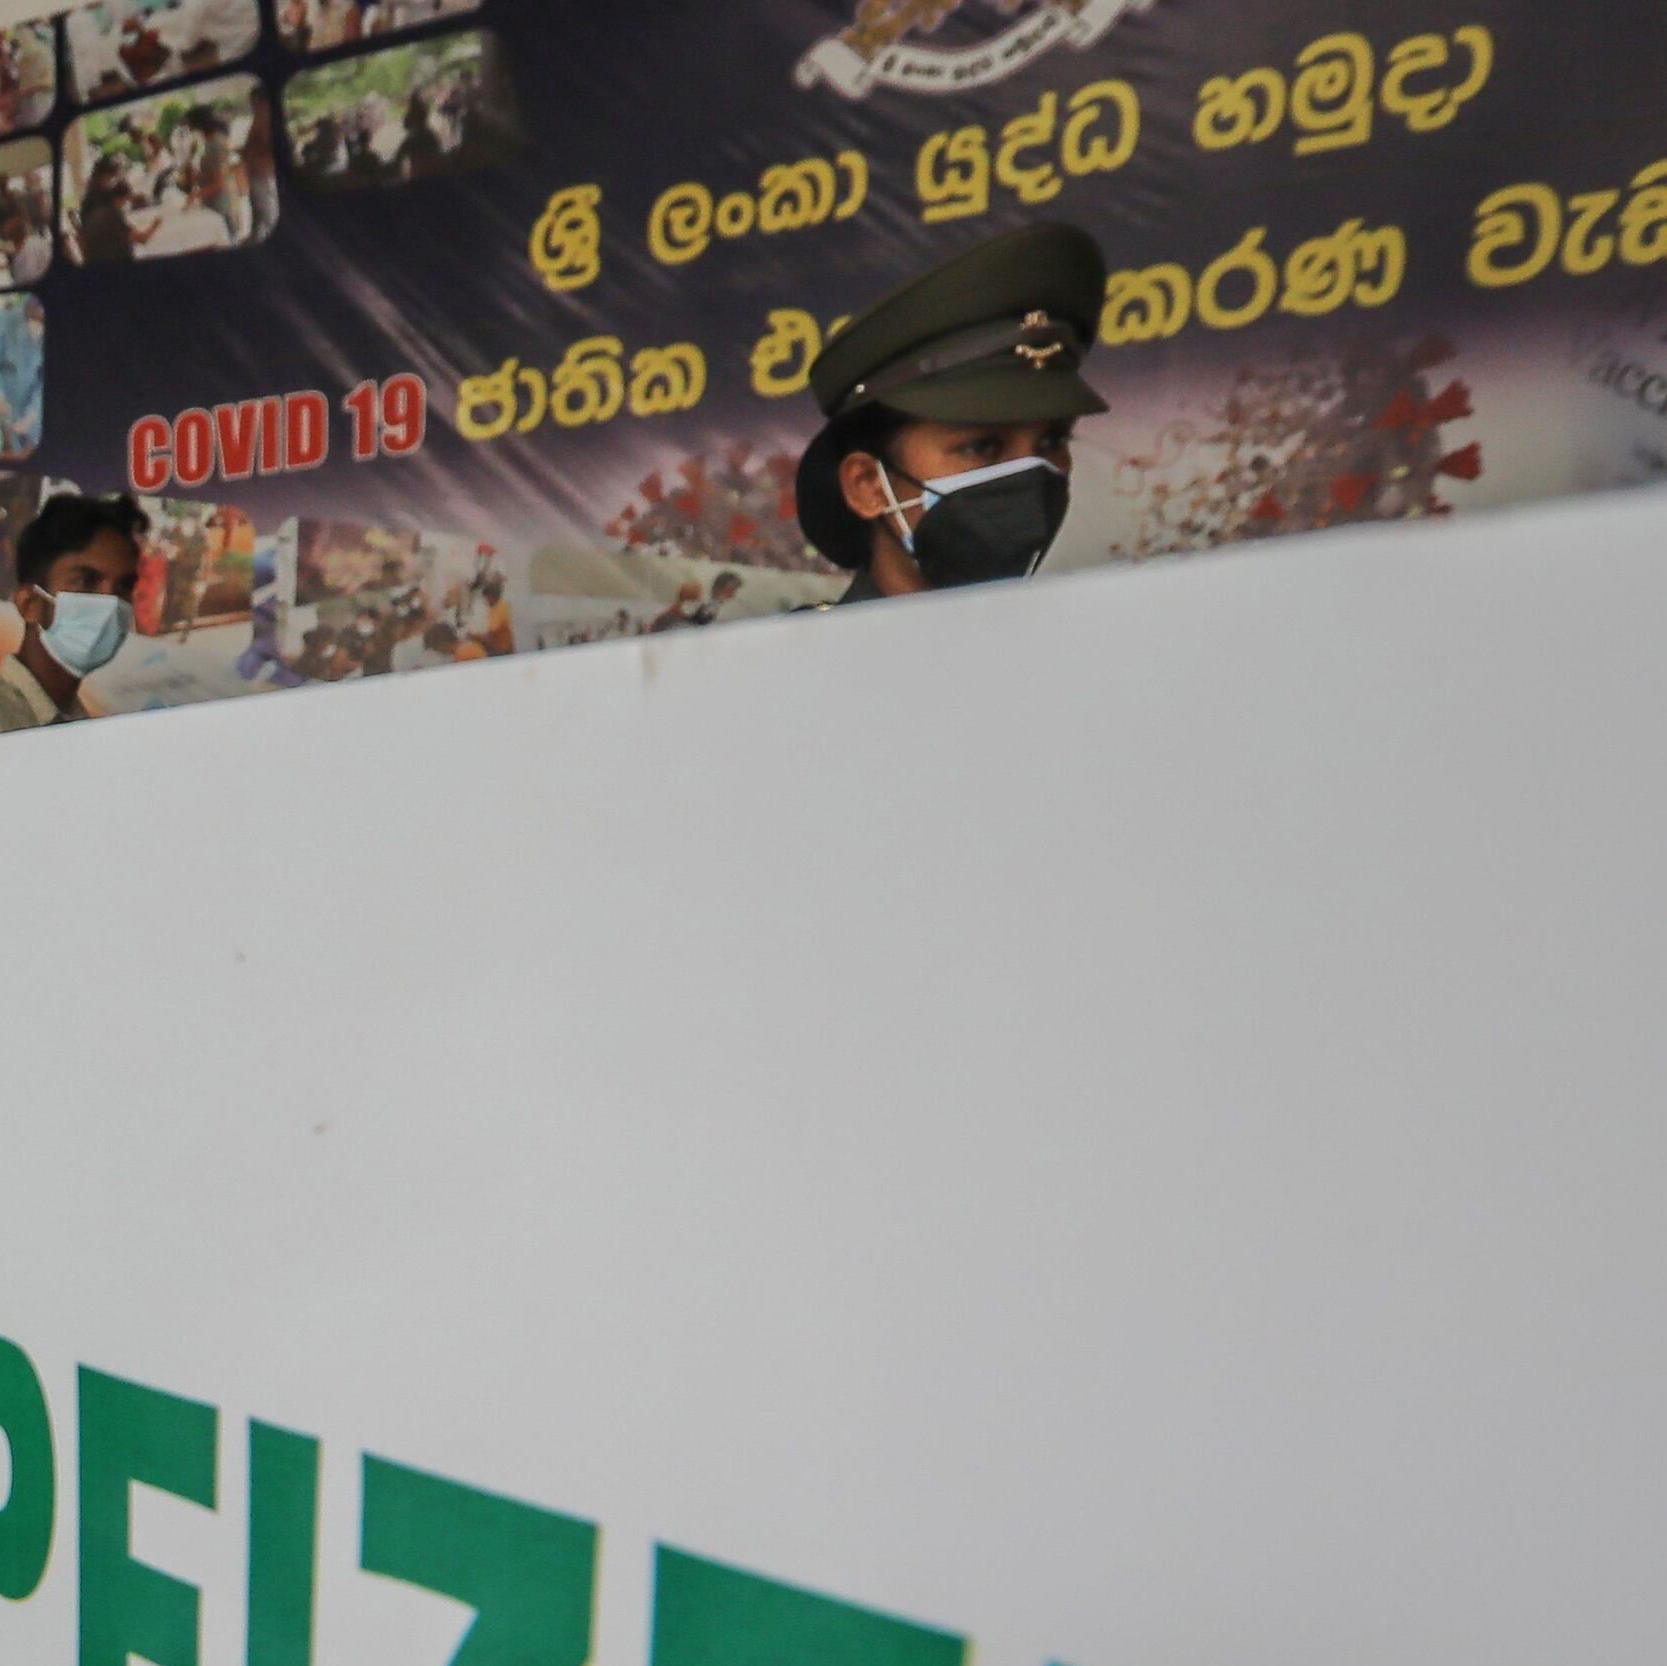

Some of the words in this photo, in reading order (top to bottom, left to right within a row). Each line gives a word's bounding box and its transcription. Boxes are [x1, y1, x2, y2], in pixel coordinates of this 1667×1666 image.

[528, 183, 602, 293] ශ්‍රී
[647, 149, 869, 265] ලංකා
[914, 78, 1142, 223] යුද්ධ
[1192, 25, 1494, 156] හමුදා
[128, 389, 329, 492] COVID
[345, 373, 427, 461] 19
[452, 335, 707, 442] ජාතික
